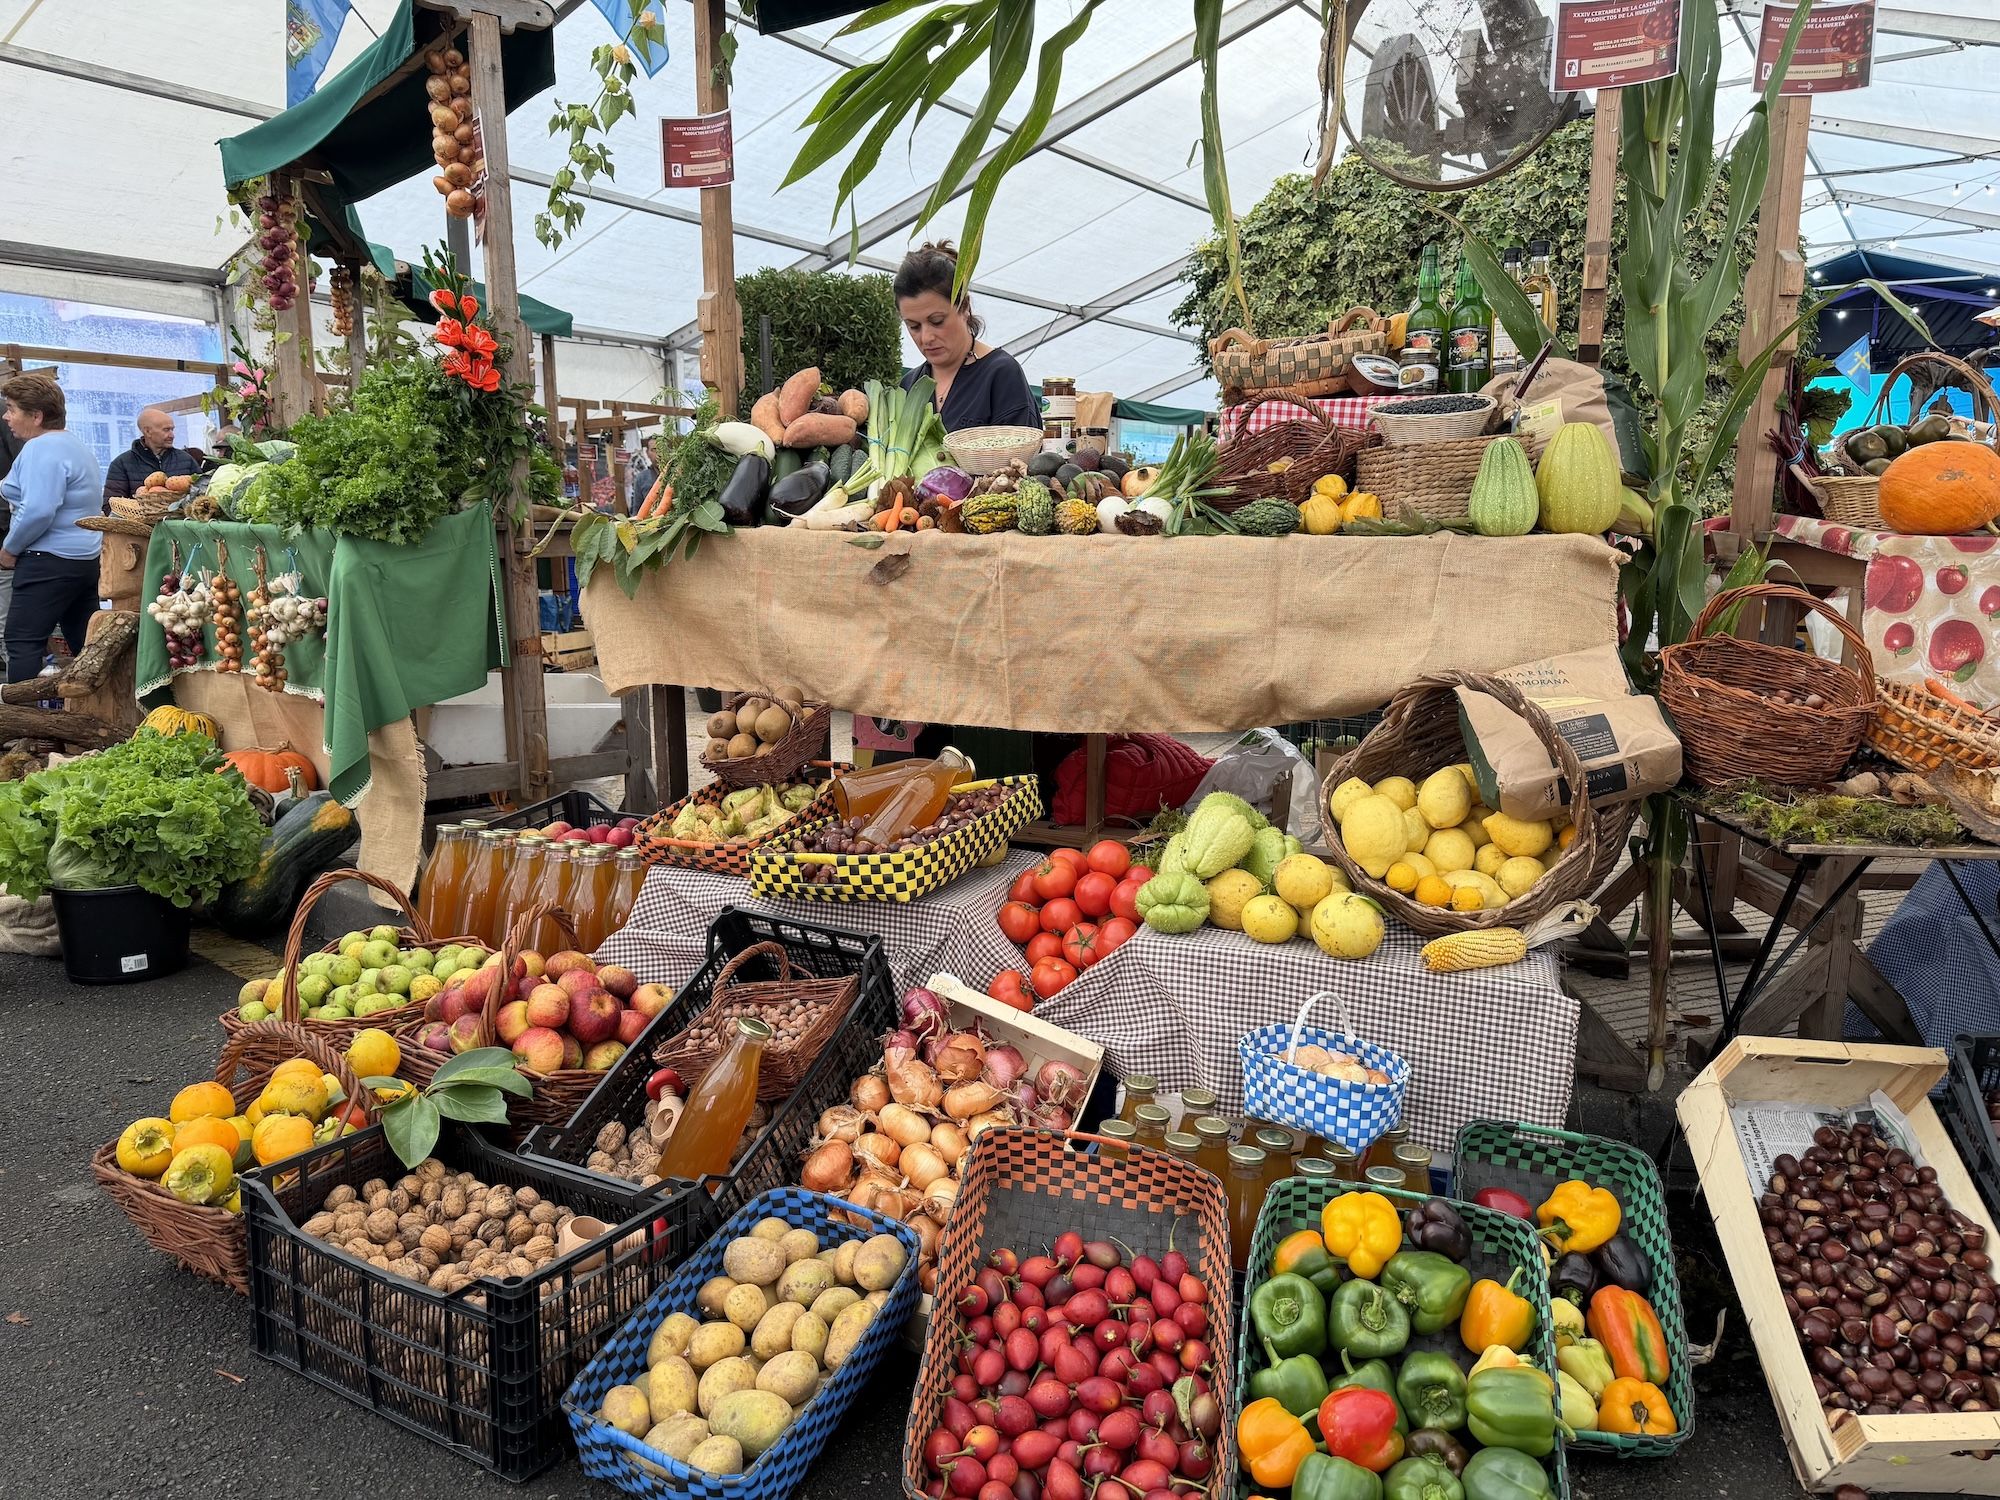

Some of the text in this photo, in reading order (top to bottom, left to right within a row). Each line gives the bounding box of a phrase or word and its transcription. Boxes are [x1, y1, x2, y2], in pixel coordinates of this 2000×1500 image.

[1584, 15, 1617, 23] PRODUCTOS
[1634, 7, 1656, 16] HUERTA
[1826, 13, 1854, 21] CASTAÑA
[1504, 669, 1567, 678] HARINA
[1514, 678, 1570, 688] AMORANA
